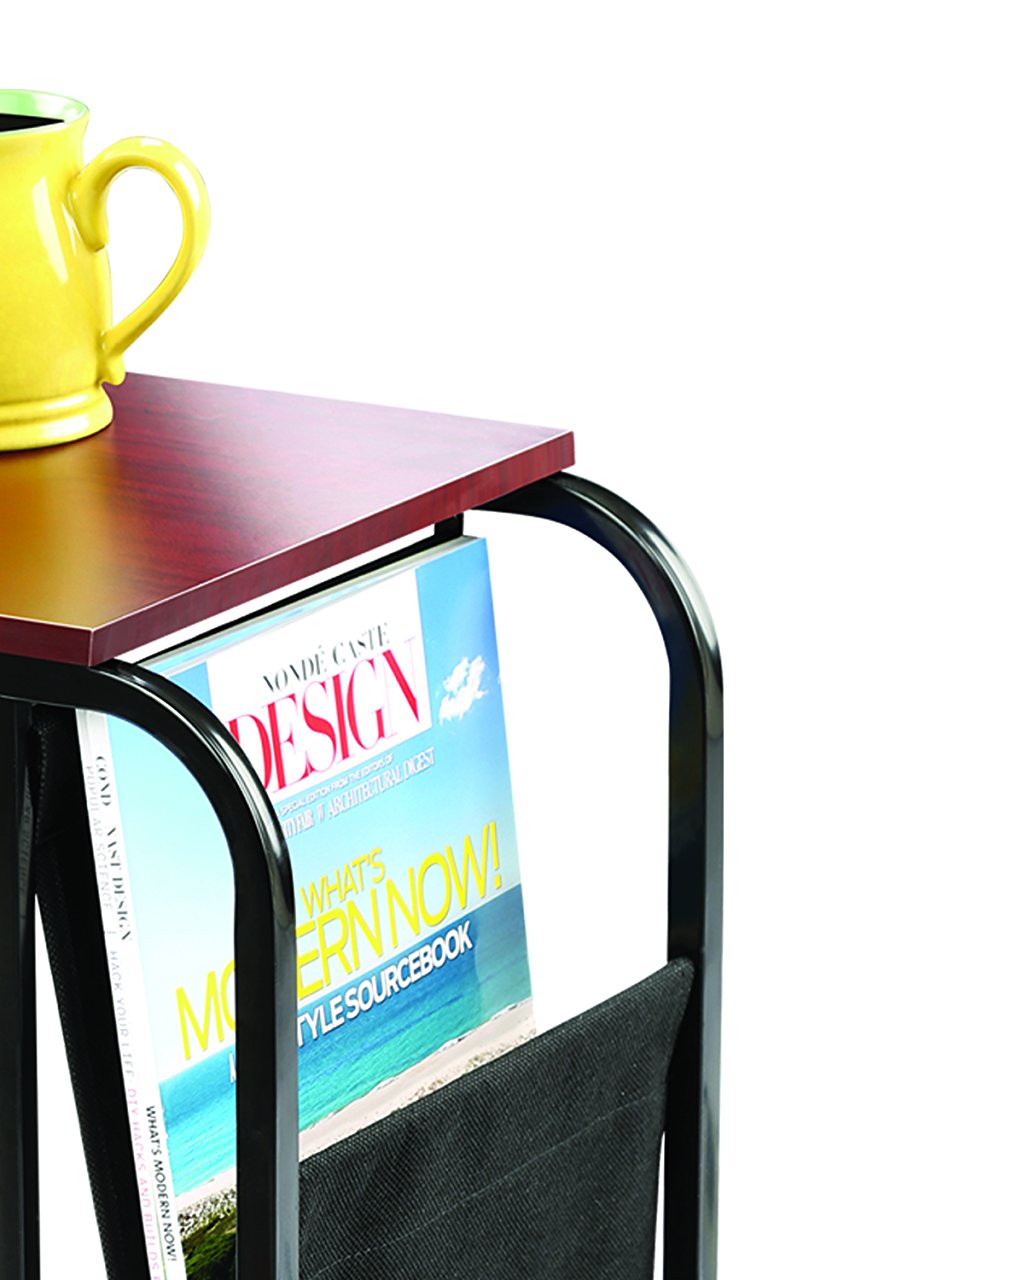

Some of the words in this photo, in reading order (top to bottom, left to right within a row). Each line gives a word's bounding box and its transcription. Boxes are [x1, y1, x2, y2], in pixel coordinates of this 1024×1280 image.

[226, 636, 420, 793] DESIGN
[327, 764, 404, 818] ARCHITECTURAL
[403, 746, 435, 780] DIGEST
[94, 843, 113, 911] SCIENCE
[299, 847, 385, 917] WHAT'S
[386, 821, 502, 949] NOW!
[344, 920, 473, 1021] SOURCEBOOK
[115, 998, 129, 1037] YOUR
[139, 1177, 152, 1208] AND
[144, 1105, 163, 1157] WHAT'S
[152, 1158, 172, 1219] MODERN
[162, 1222, 179, 1262] NOW!
